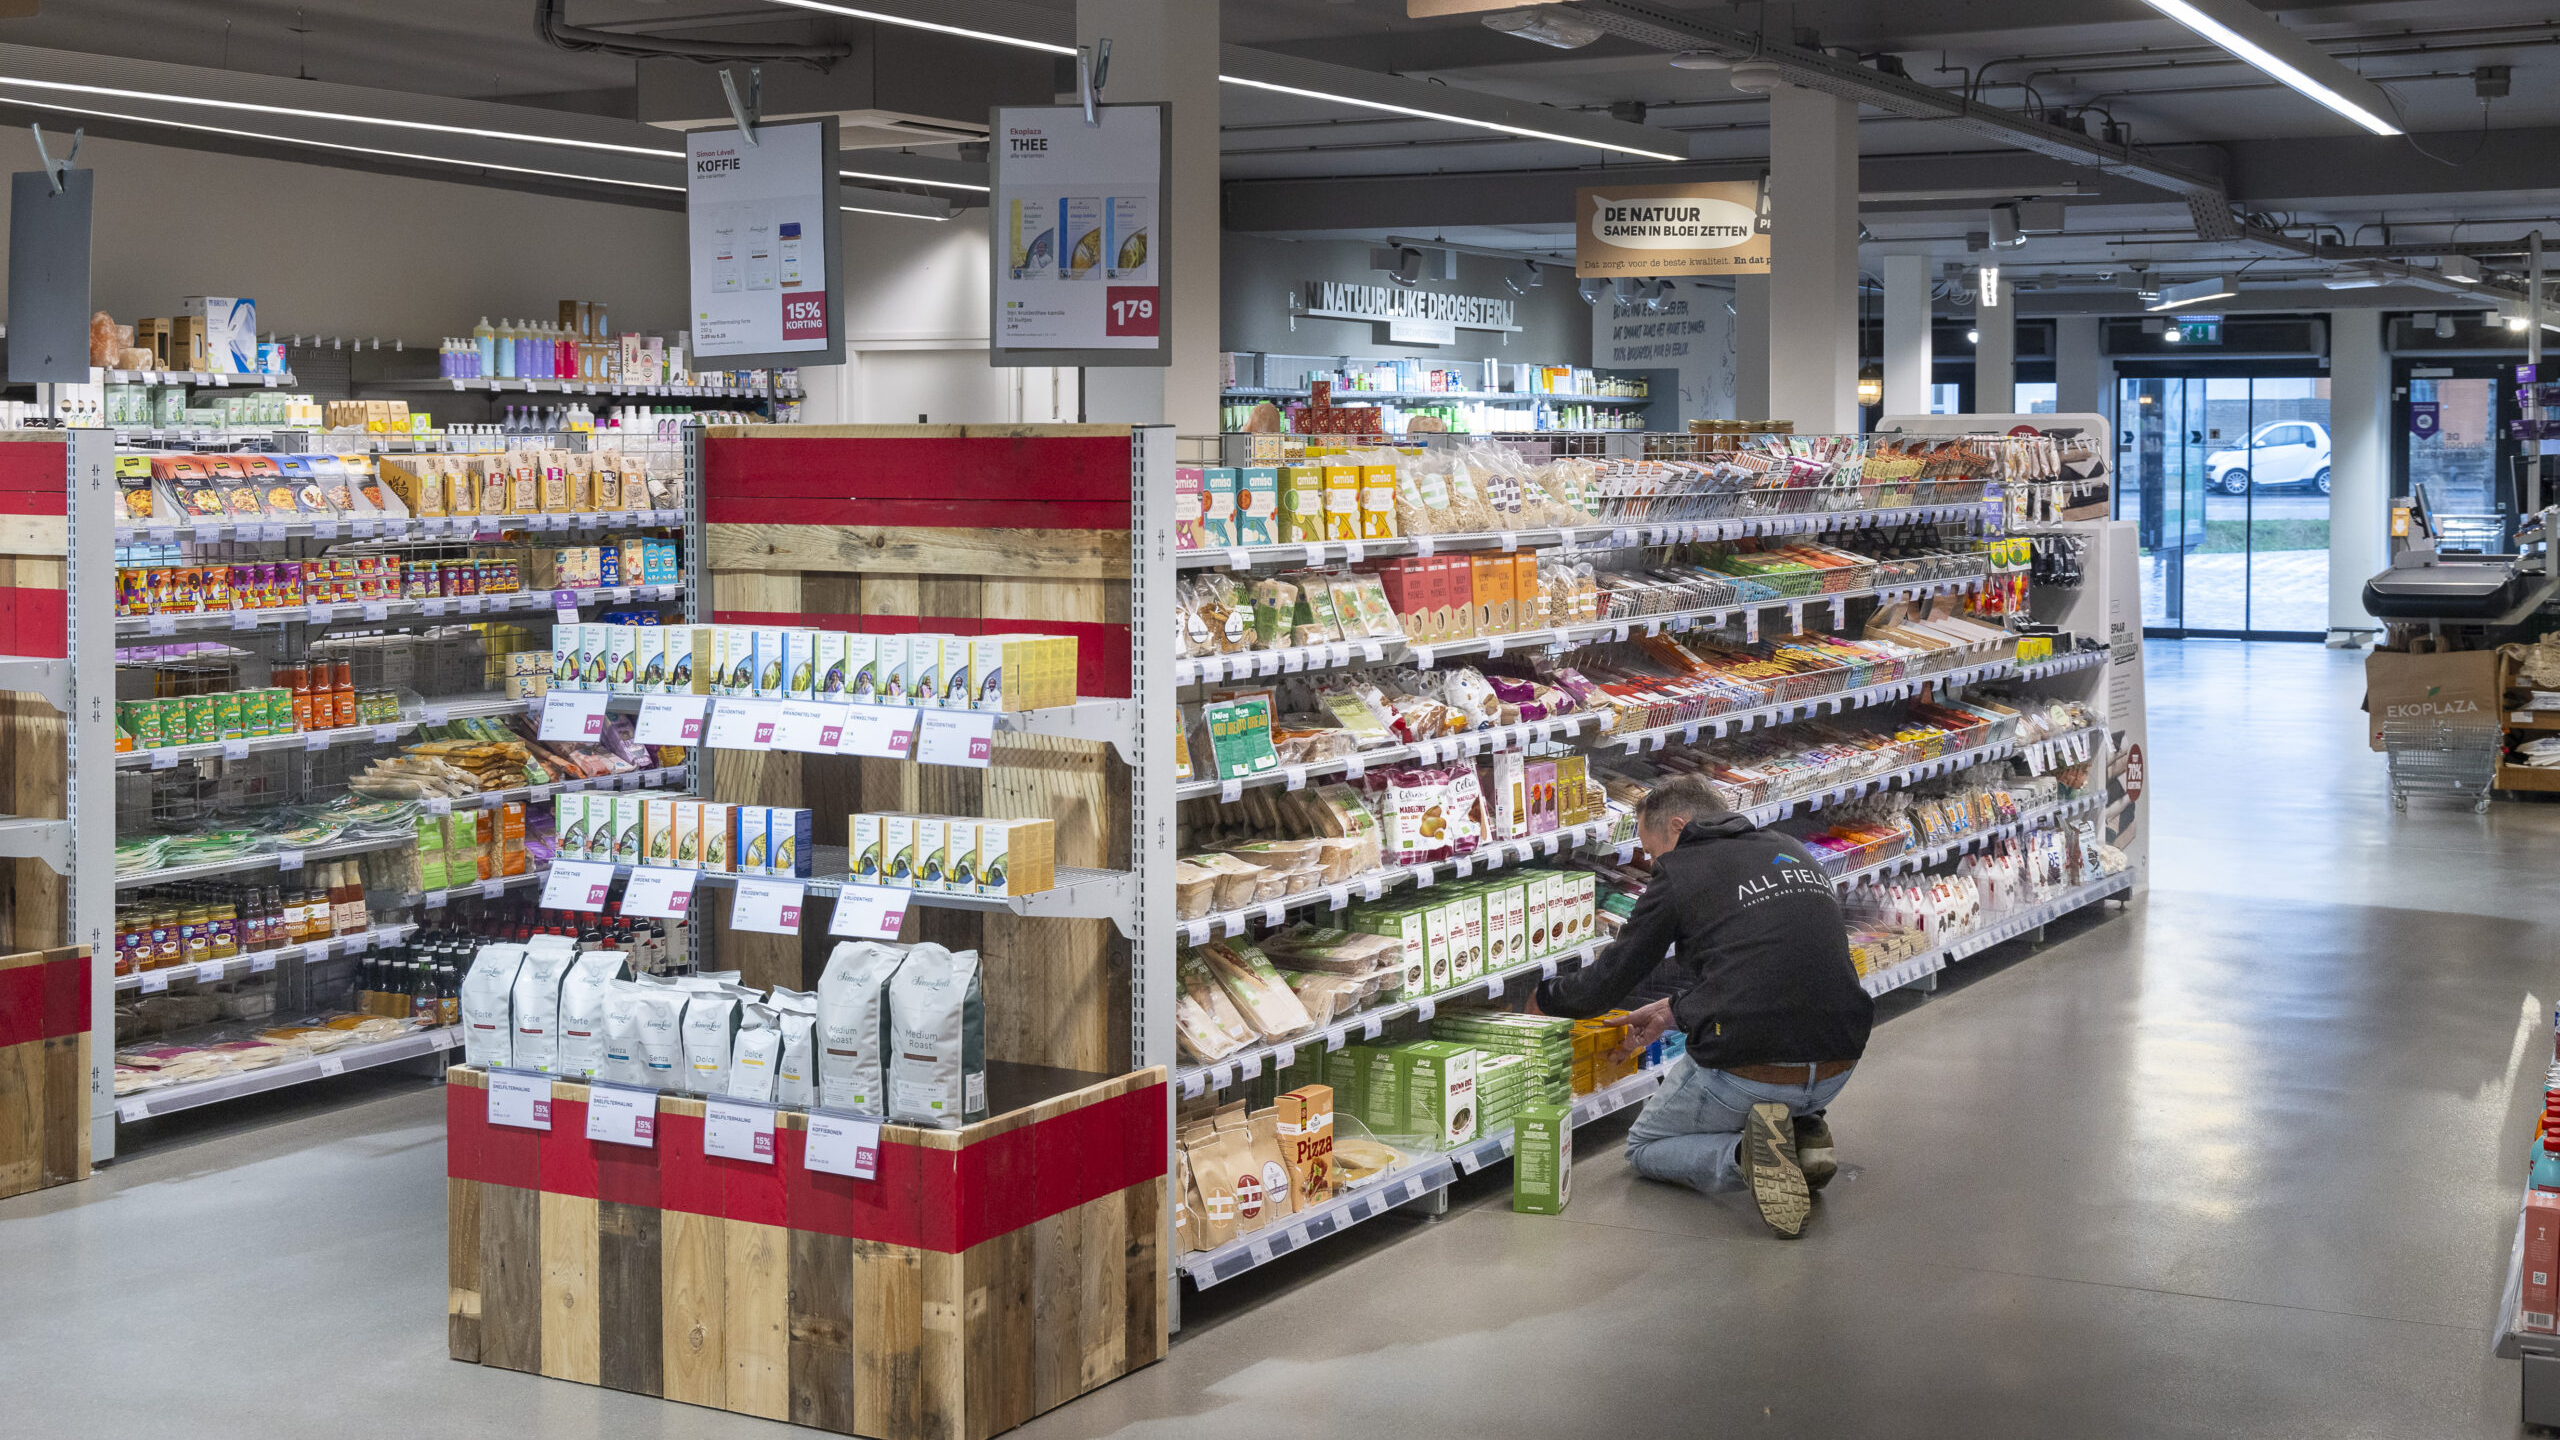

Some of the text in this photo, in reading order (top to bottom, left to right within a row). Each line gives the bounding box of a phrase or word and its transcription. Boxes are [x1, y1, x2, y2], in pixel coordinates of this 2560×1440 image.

[1010, 138, 1048, 151] THEE
[696, 150, 716, 158] Simon
[697, 158, 741, 173] KOFFIE
[1604, 206, 1701, 222] DE NATUUR
[1604, 225, 1748, 237] SAMEN IN BLOEI ZETTEN
[1584, 256, 1764, 270] Dat zorgt voor de beste kwaliteit. En dat
[1323, 281, 1515, 327] NATUURLIJKE DROGISTERIJ
[787, 301, 821, 320] 15%
[786, 319, 823, 330] KORTING
[1210, 475, 1232, 488] amisa
[1250, 474, 1272, 487] amisa
[1297, 473, 1318, 486] amisa
[1333, 472, 1355, 484] amisa
[1370, 471, 1392, 483] amisa
[2110, 622, 2126, 635] SPAAR
[2110, 632, 2134, 646] VOOR LUXE
[2387, 700, 2478, 718] EKOPLAZA
[2128, 763, 2142, 780] 70%
[2048, 852, 2060, 868] 85
[1738, 875, 1778, 900] ALL
[1743, 894, 1770, 908] TAKING
[1774, 888, 1794, 897] CARE
[1810, 888, 1825, 896] YOUR
[474, 1010, 493, 1019] Forte
[570, 1016, 588, 1026] Forte
[829, 1026, 858, 1036] Medium
[905, 1029, 938, 1041] Medium
[830, 1036, 852, 1046] Roast
[908, 1039, 934, 1050] Roast
[608, 1046, 628, 1055] Senza
[744, 1050, 764, 1060] Dolce
[650, 1054, 669, 1063] Senza
[695, 1055, 716, 1064] Dolce
[493, 1084, 530, 1092] SNELFILTERMALING
[1450, 1082, 1464, 1092] BROWN
[535, 1104, 549, 1114] 15%
[593, 1098, 633, 1108] SNELFILTERMALING
[710, 1113, 751, 1124] SNELFILTERMALING
[637, 1120, 651, 1130] 15%
[812, 1126, 842, 1136] KOFFIEBONEN
[756, 1136, 771, 1146] 15%
[1296, 1135, 1333, 1165] Pizza
[858, 1152, 873, 1162] 15%
